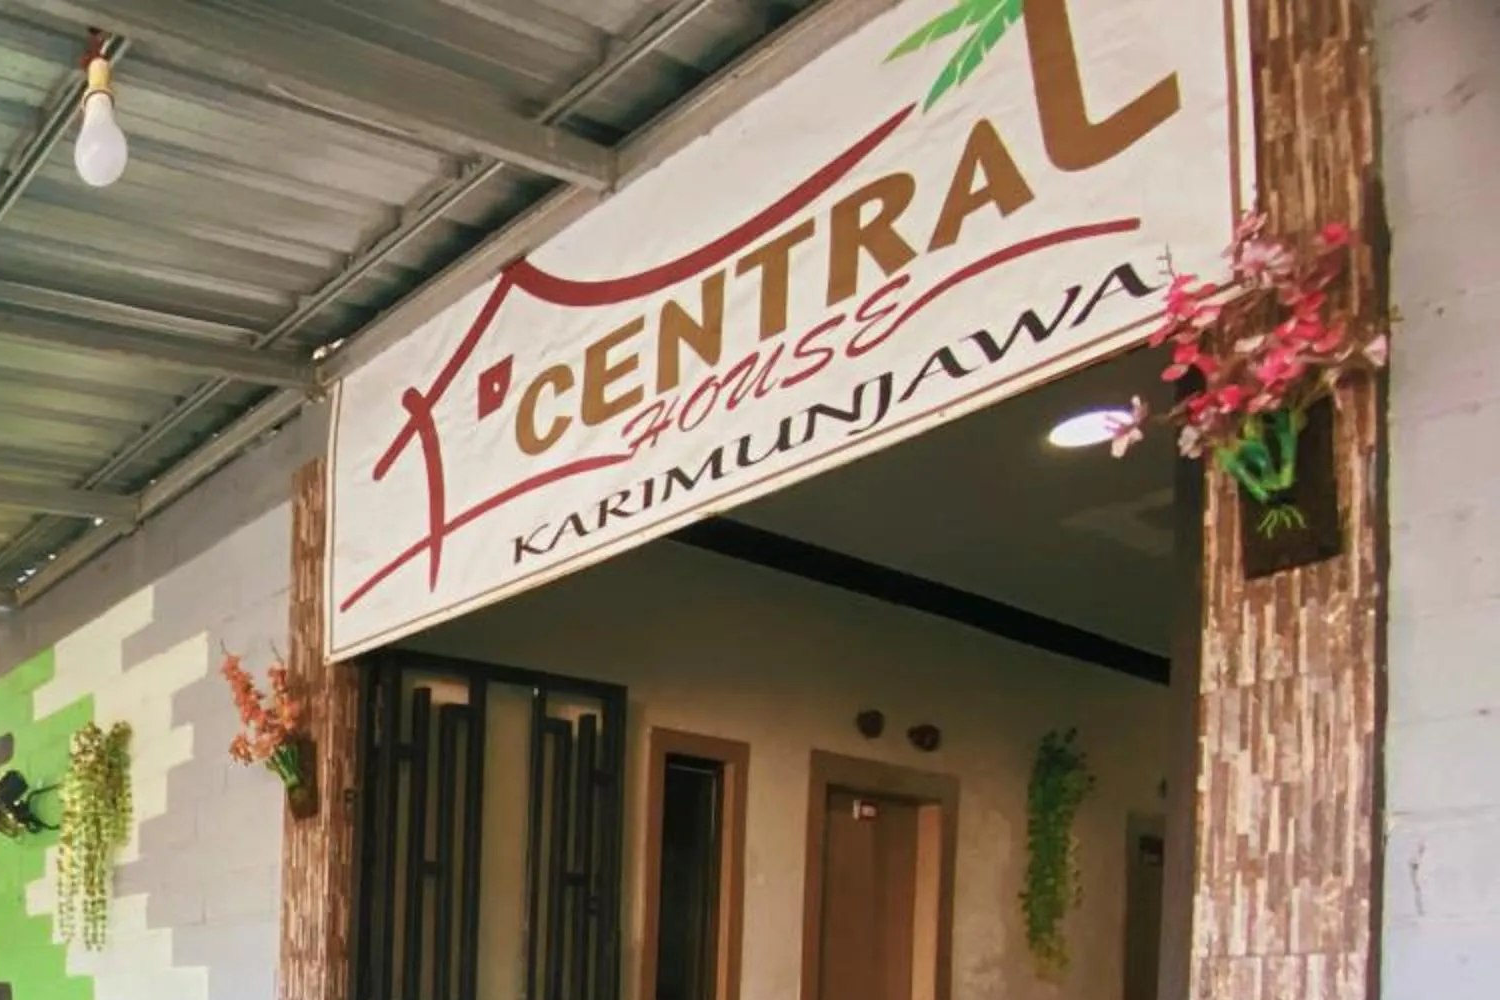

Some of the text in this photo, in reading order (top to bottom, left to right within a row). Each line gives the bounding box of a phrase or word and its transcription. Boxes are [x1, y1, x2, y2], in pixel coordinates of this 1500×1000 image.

[515, 0, 1182, 456] CENTRAL
[620, 273, 911, 456] HOUSE
[511, 262, 1168, 564] KARIMUNJAWA
